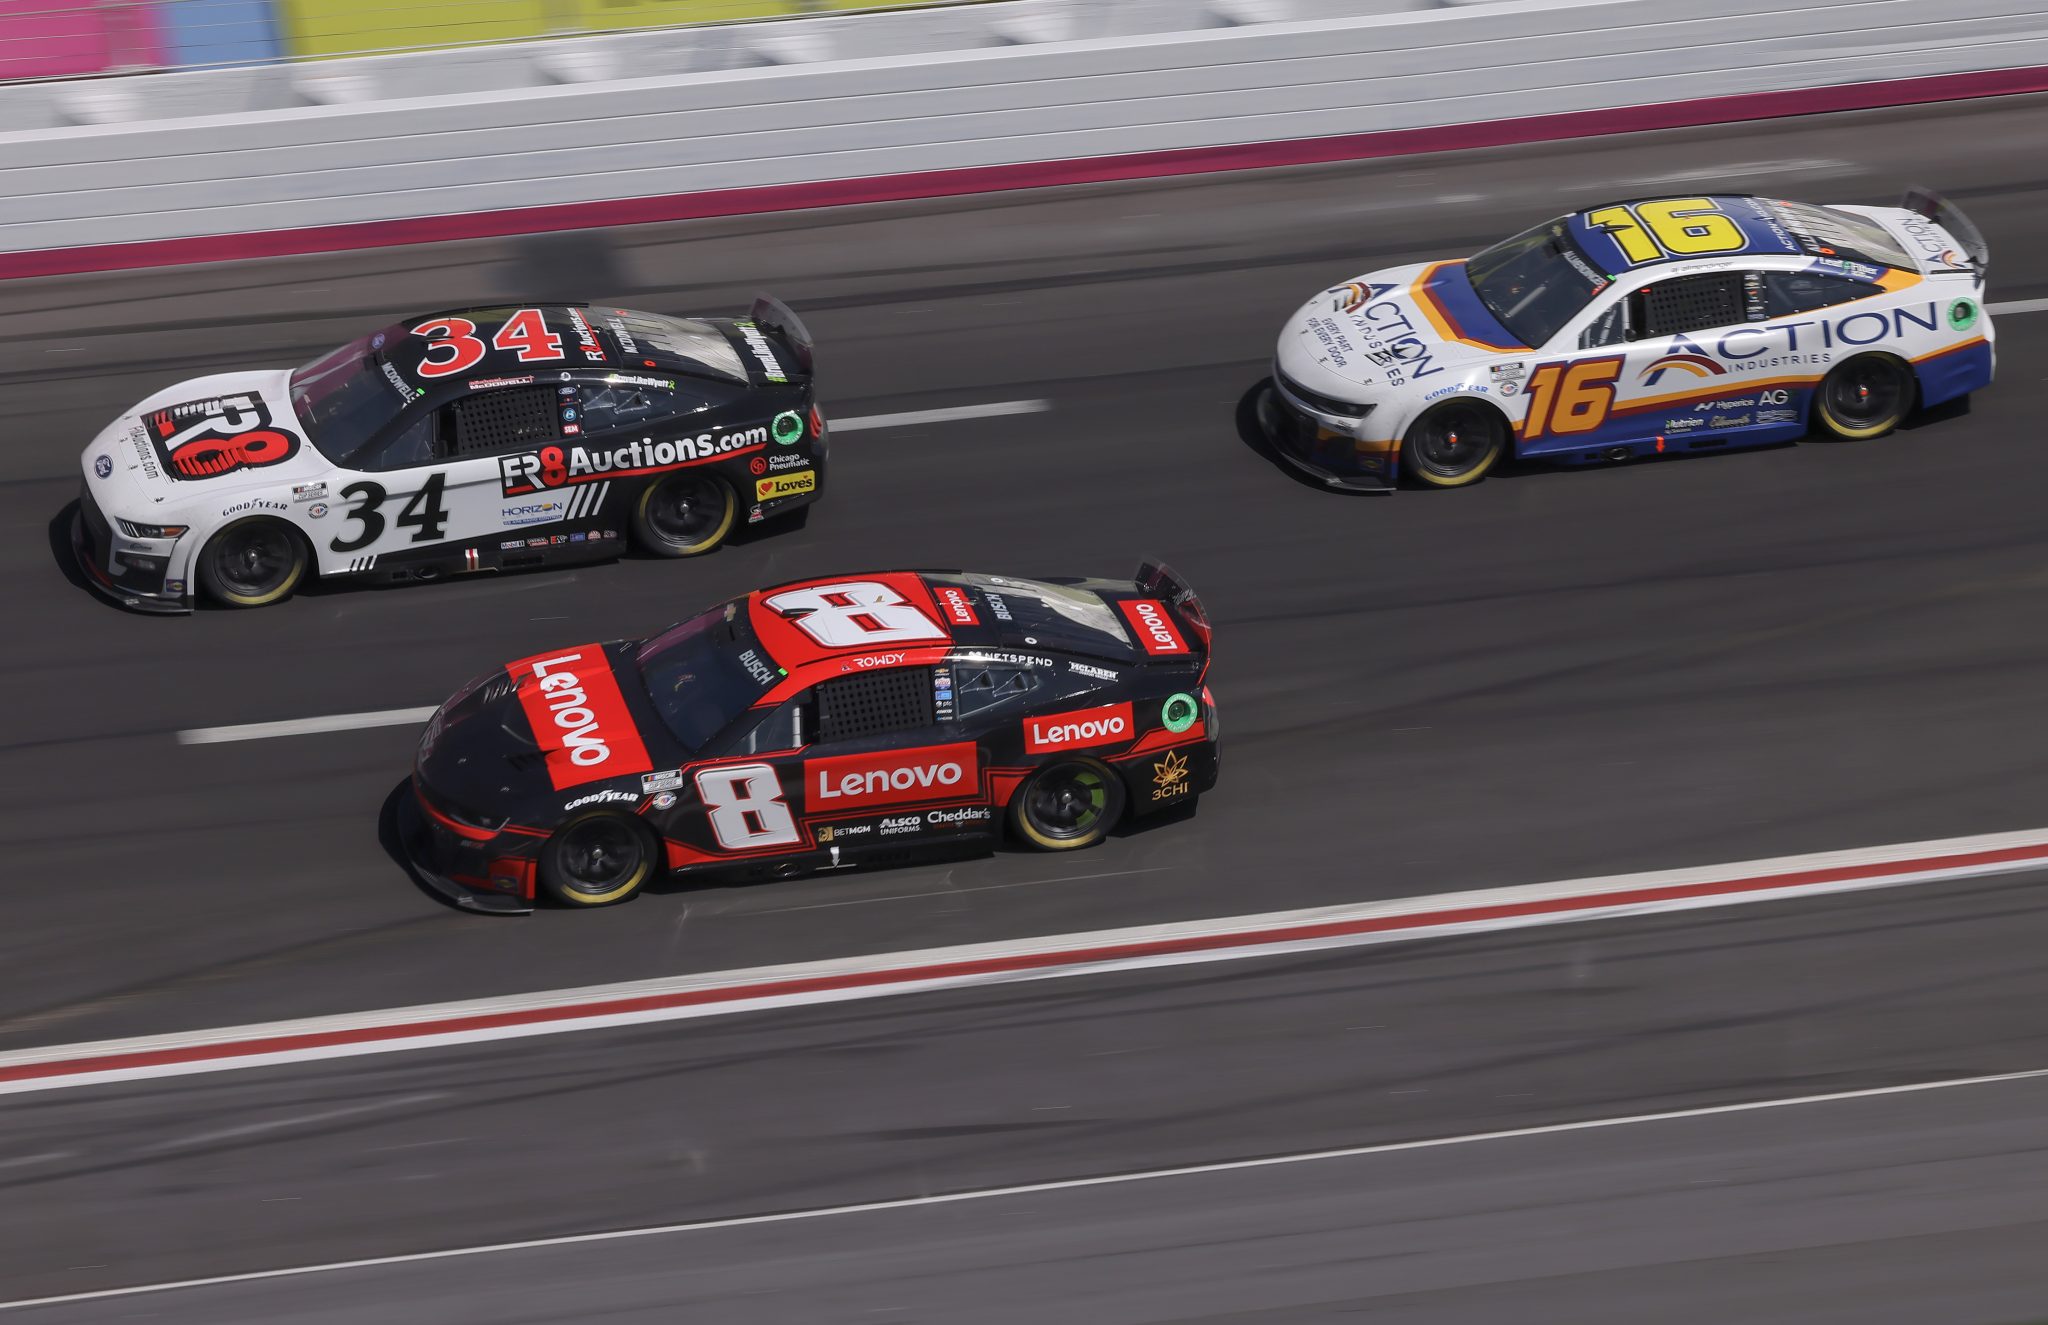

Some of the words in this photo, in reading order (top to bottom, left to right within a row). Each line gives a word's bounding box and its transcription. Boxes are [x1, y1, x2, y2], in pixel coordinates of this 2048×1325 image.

[1583, 196, 1749, 267] 16
[408, 307, 567, 379] 34
[1640, 301, 1939, 387] ACTION
[1728, 353, 1832, 374] INDUSTRIES
[1522, 354, 1627, 441] 16
[1758, 389, 1789, 406] AG
[769, 453, 800, 464] Chicago
[769, 458, 810, 471] Pneumatic
[329, 472, 450, 553] 34
[763, 580, 952, 649] 8
[945, 590, 972, 622] Lenovo
[1136, 604, 1178, 650] Lenovo
[739, 649, 775, 686] BUSCH
[853, 653, 905, 668] ROWDY
[532, 653, 610, 767] Lenovo
[1033, 716, 1125, 745] Lenovo
[819, 761, 962, 799] Lenovo
[1151, 781, 1189, 801] 3CHI
[564, 789, 639, 811] GOODYEAR
[695, 763, 802, 850] 8
[927, 807, 991, 824] Cheddar's
